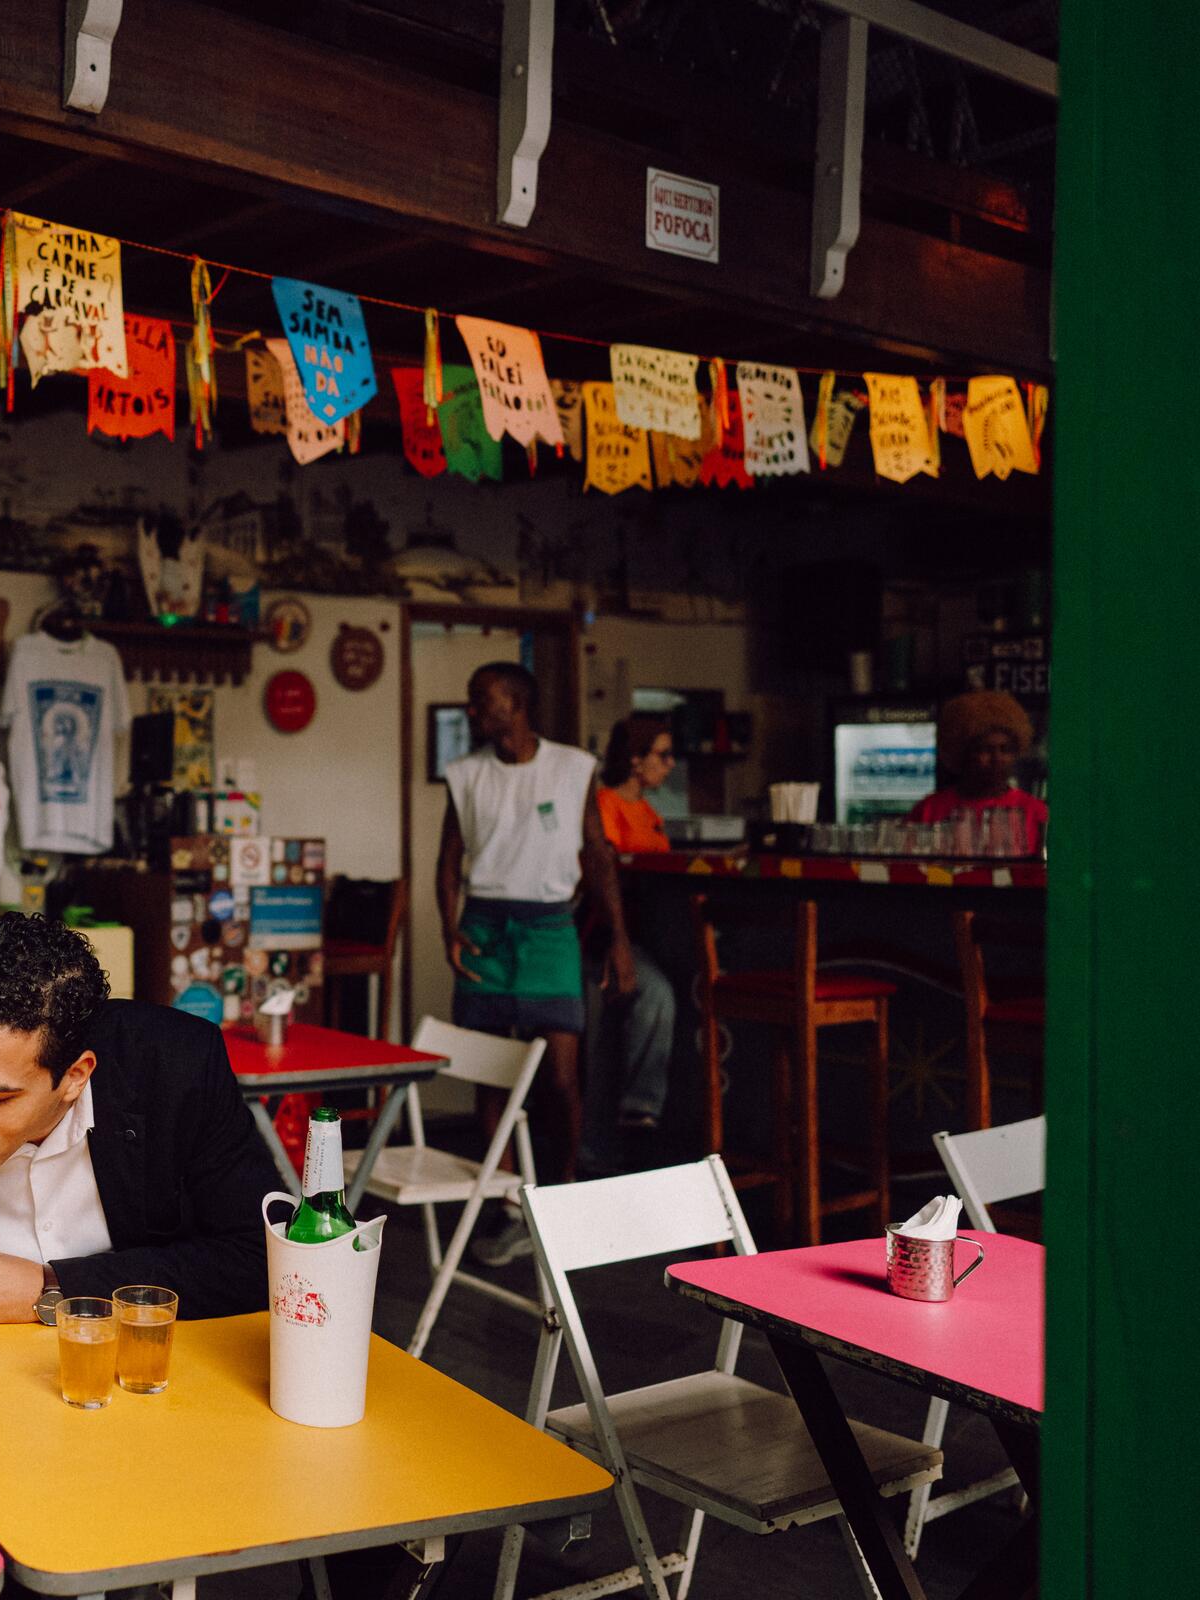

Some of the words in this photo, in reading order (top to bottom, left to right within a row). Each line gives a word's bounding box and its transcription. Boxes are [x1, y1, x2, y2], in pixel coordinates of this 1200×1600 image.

[655, 211, 712, 243] FOFOCA
[38, 243, 98, 280] CARNE
[44, 268, 51, 282] E
[62, 274, 76, 293] DE
[30, 285, 109, 320] CARNAVAL
[302, 289, 344, 327] SEM
[289, 312, 355, 356] SAMBA
